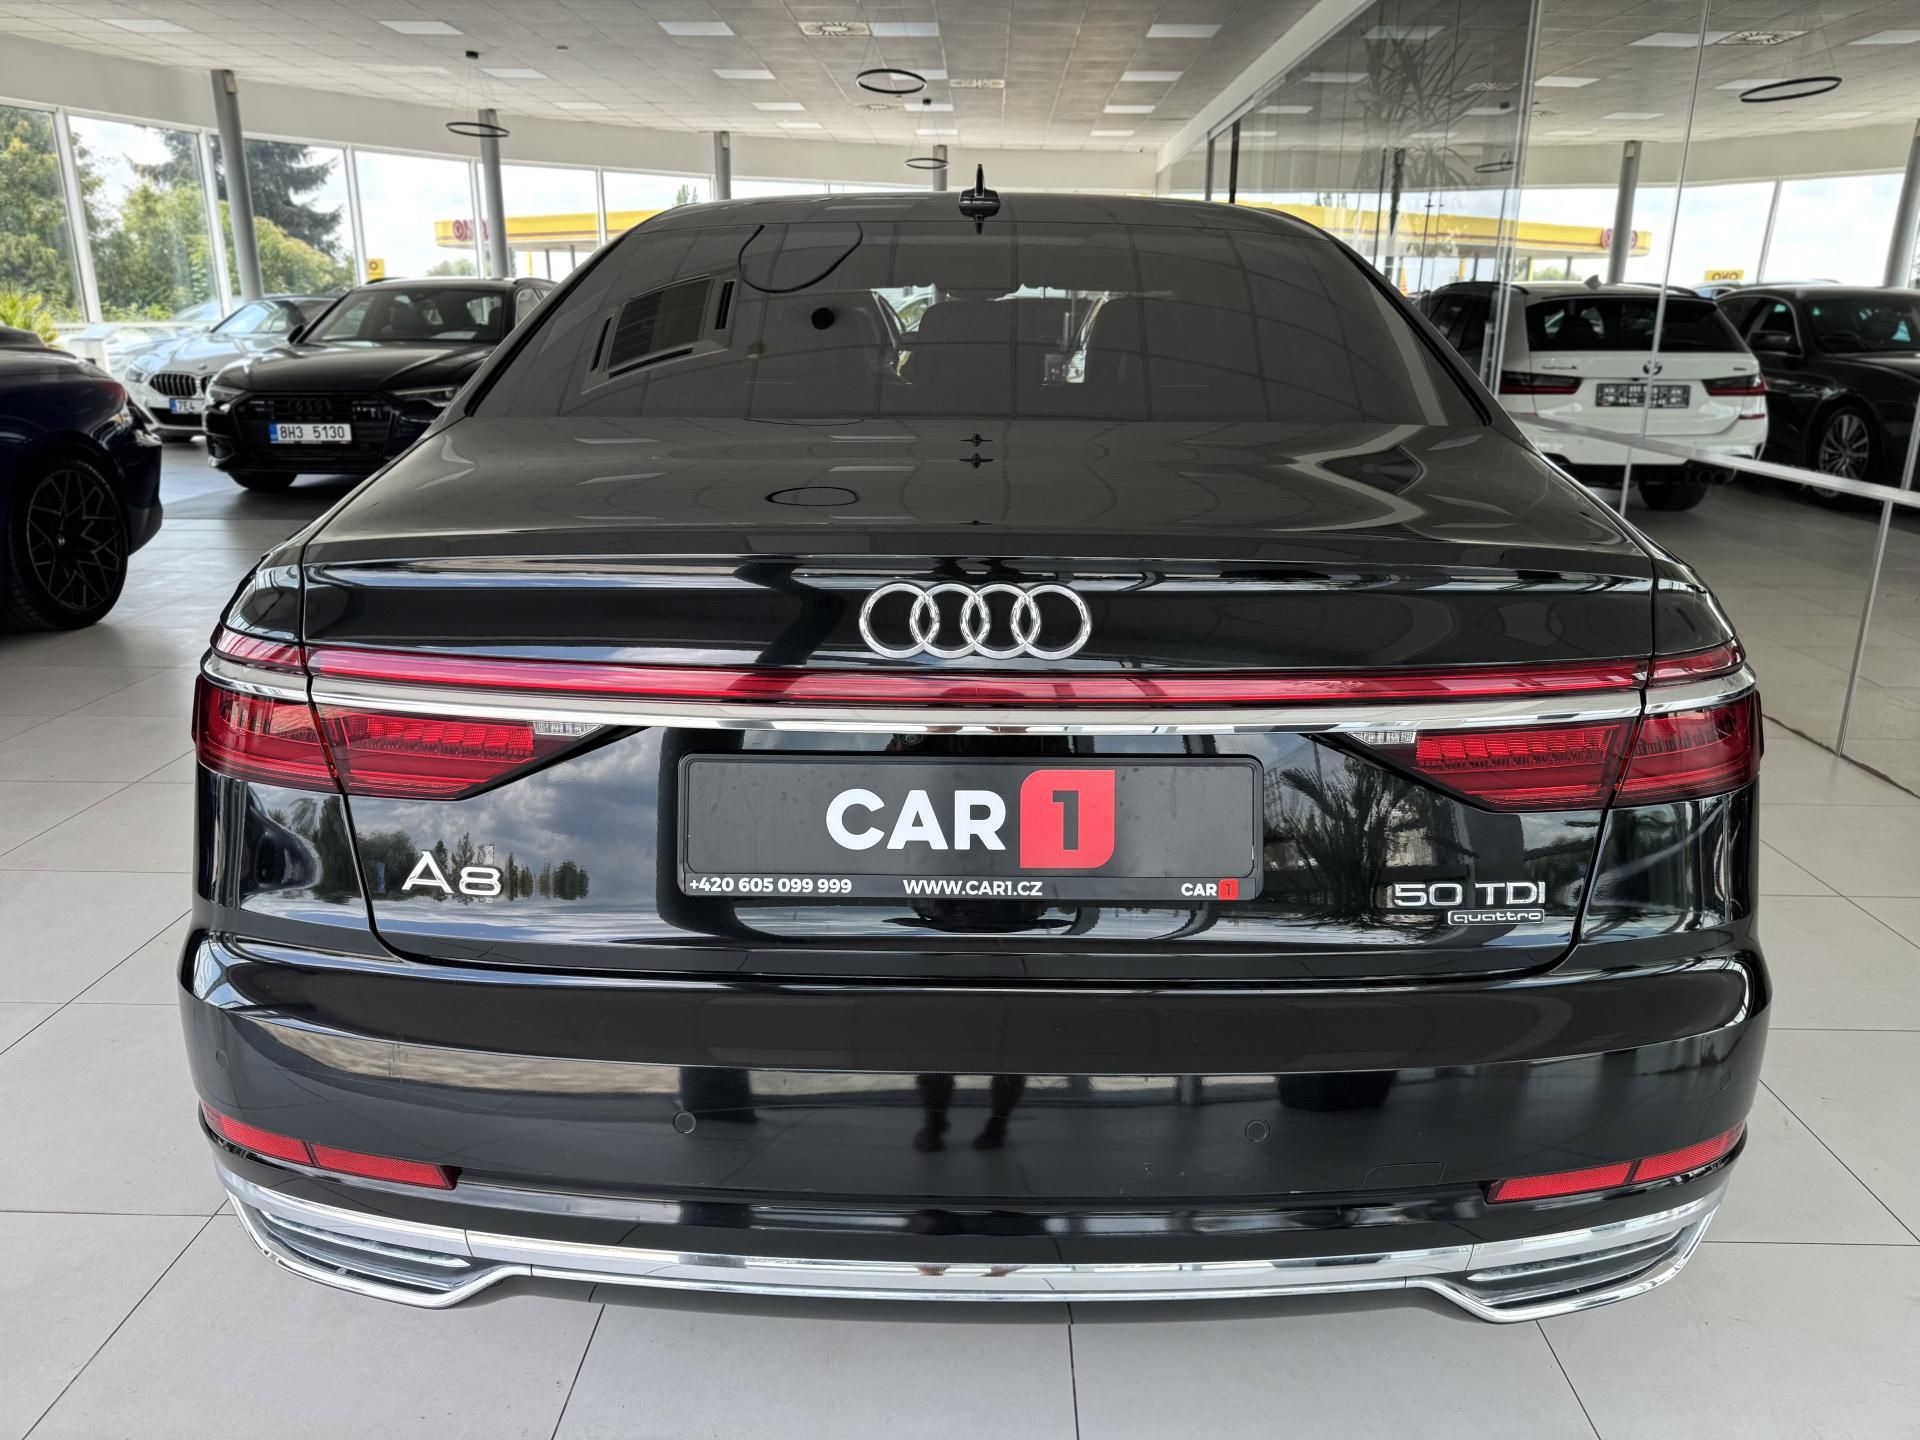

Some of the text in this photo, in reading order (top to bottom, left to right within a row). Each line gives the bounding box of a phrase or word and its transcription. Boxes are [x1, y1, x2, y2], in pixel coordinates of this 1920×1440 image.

[280, 426, 346, 439] 8H3 5130
[401, 850, 502, 896] A8
[690, 877, 852, 893] +420 605 099 999
[903, 879, 1043, 896] WWW.CAR1.CZ
[1394, 881, 1545, 907] 50 TDI
[1453, 911, 1541, 924] quattro
